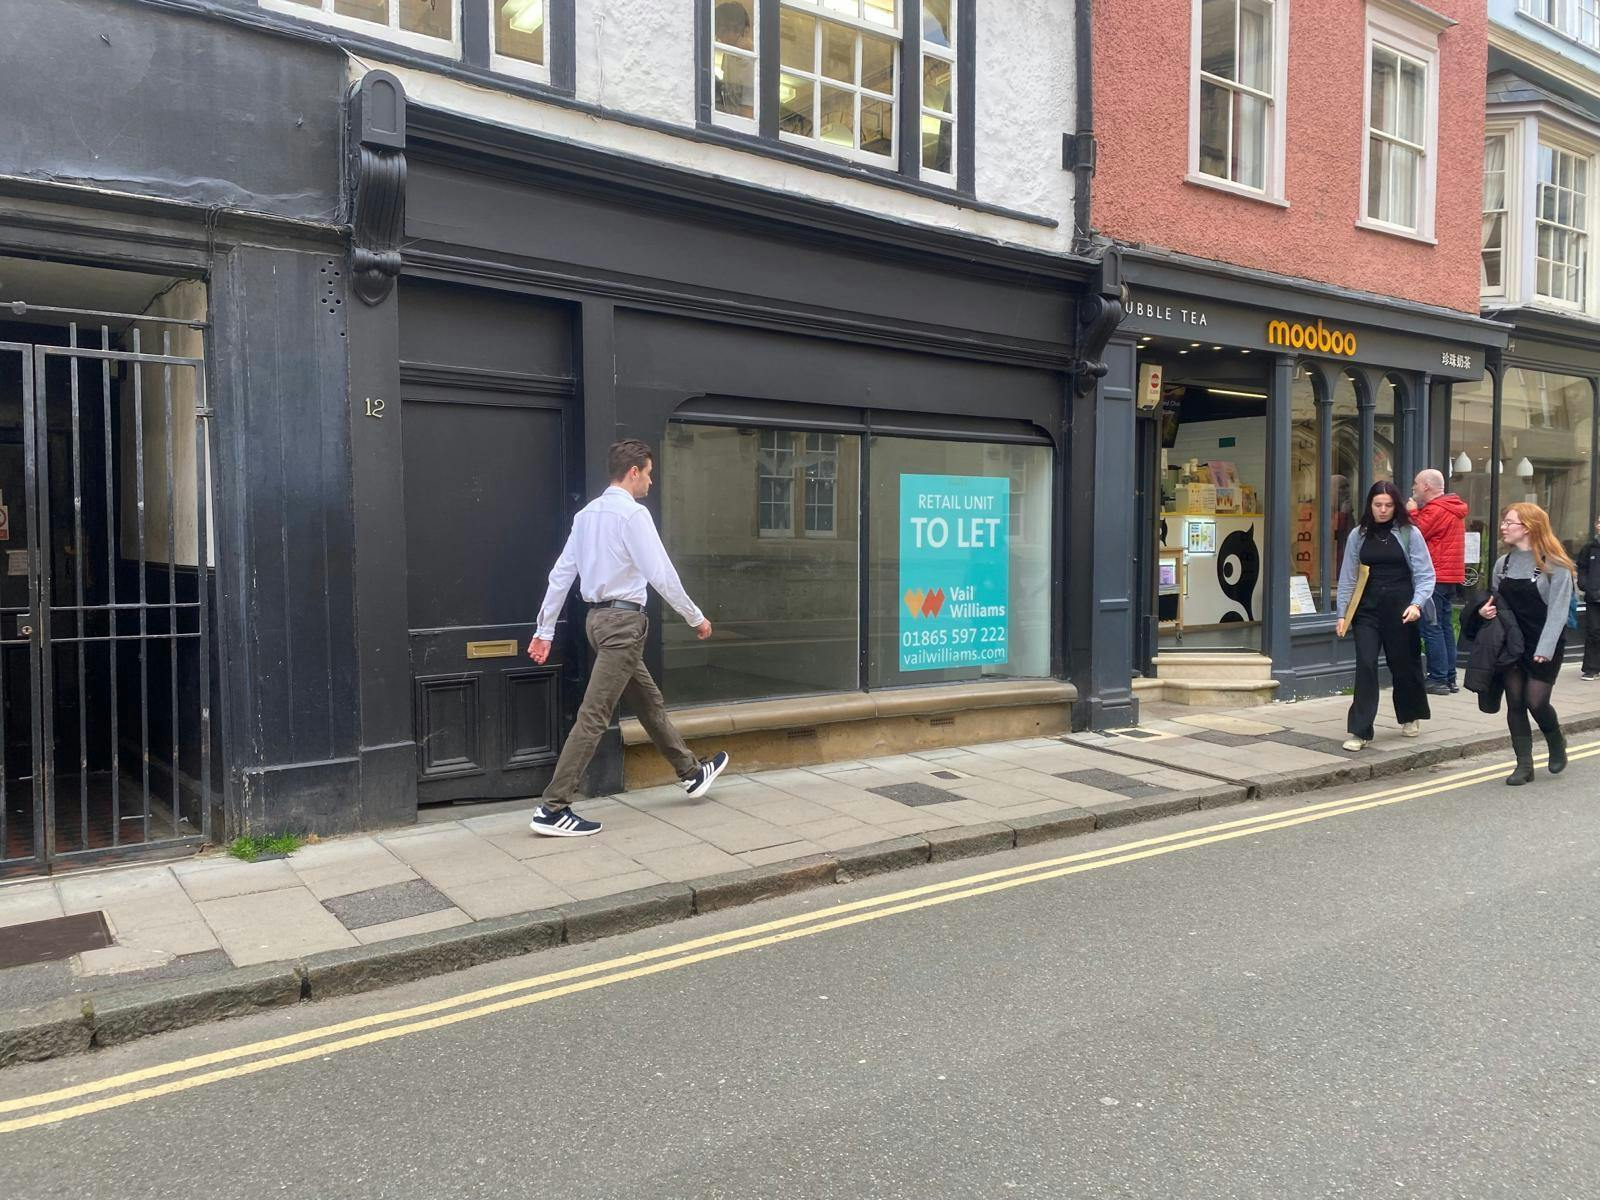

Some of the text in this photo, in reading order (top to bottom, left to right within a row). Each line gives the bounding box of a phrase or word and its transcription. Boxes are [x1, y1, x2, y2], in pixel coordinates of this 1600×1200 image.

[1125, 301, 1207, 326] UBBLE TEA
[1268, 319, 1357, 356] mooboo
[1441, 352, 1472, 369] 珍珠奶茶
[365, 397, 385, 418] 12
[919, 495, 994, 510] RETAIL UNIT
[910, 517, 1000, 548] TO LET
[950, 586, 973, 601] Vail
[950, 604, 1005, 618] Williams
[903, 627, 1005, 647] 01865 597 222
[904, 647, 1005, 665] vailwilliams.com
